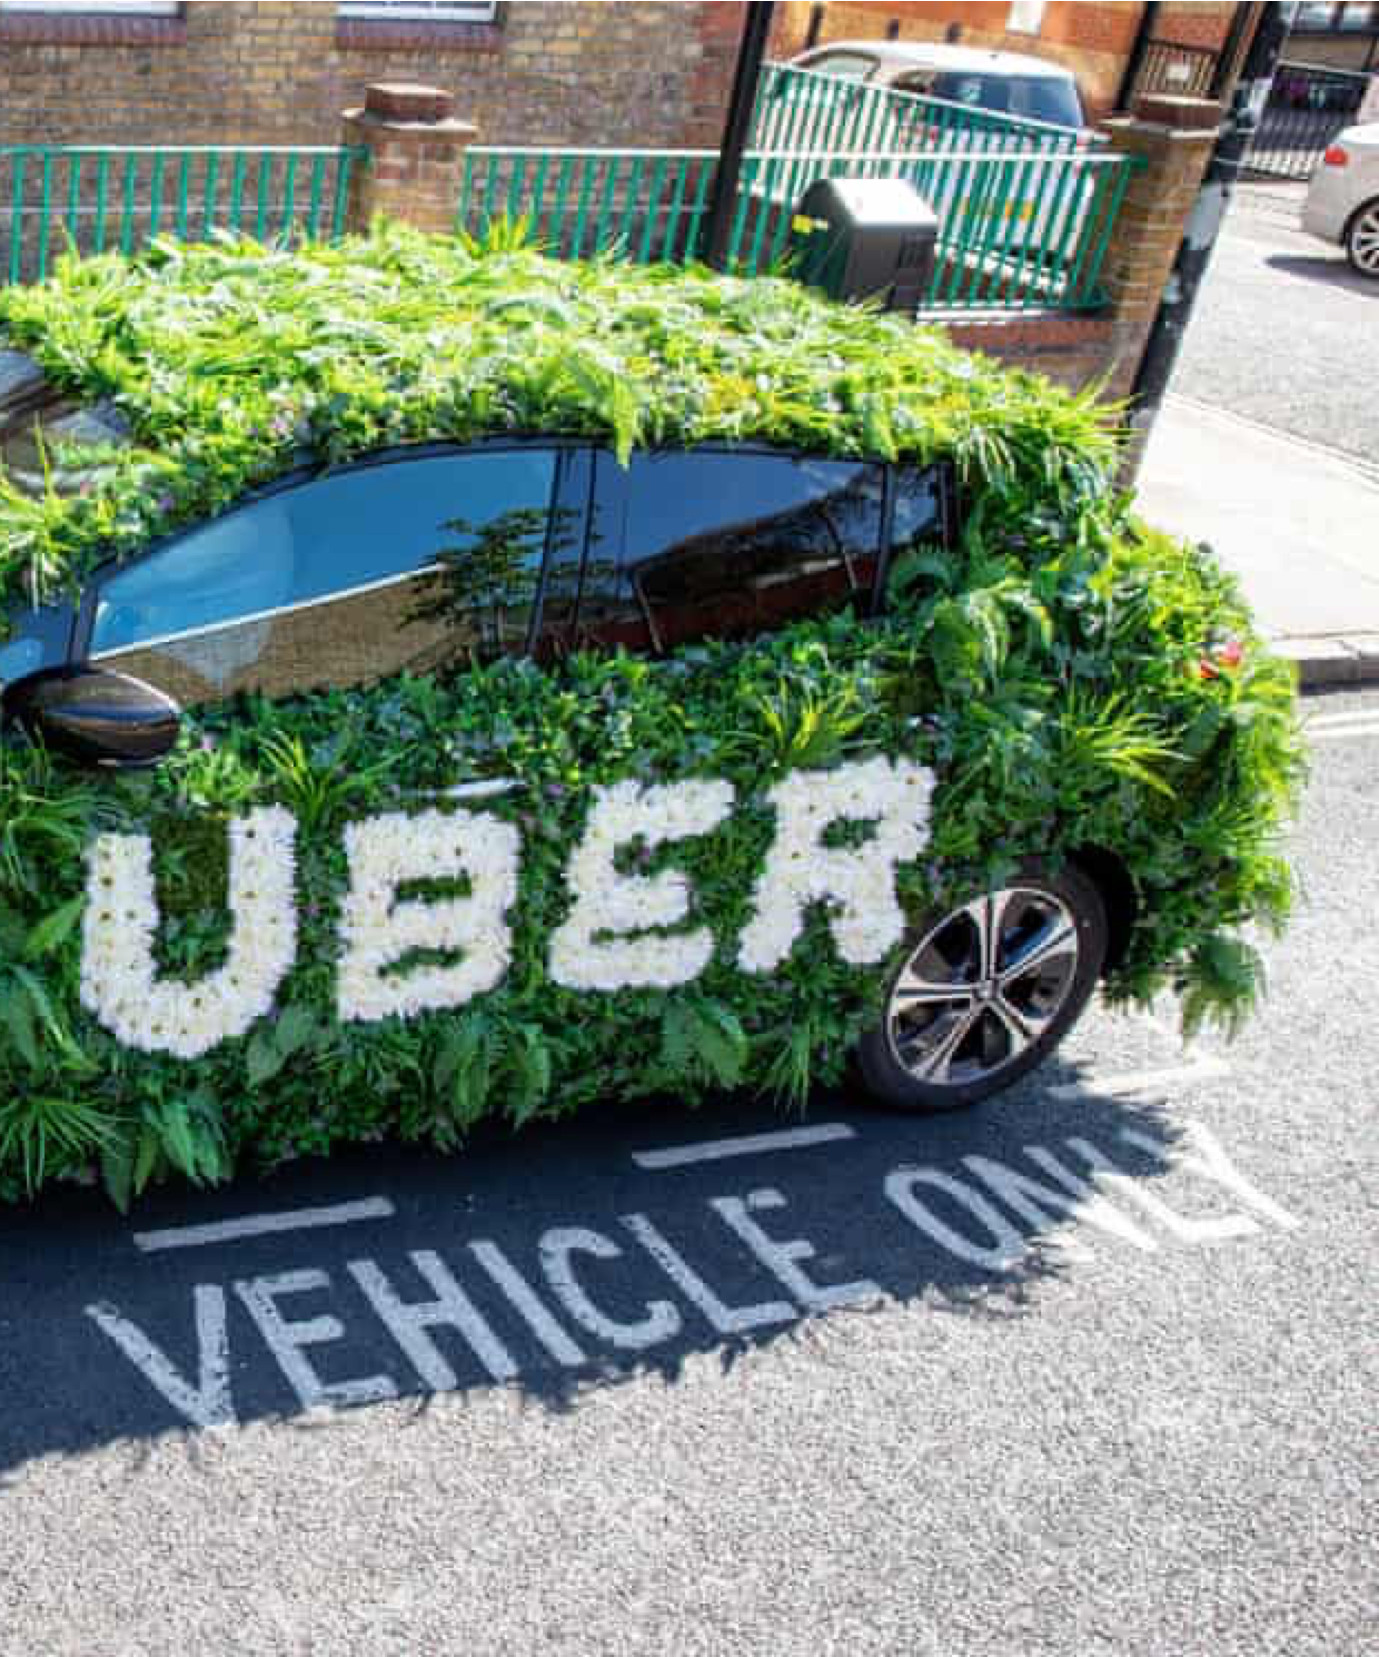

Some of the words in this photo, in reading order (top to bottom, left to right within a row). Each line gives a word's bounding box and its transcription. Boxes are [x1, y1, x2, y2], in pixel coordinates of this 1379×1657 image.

[79, 756, 937, 1060] UBER
[84, 1188, 880, 1431] VEHICLE
[884, 1118, 1302, 1272] ONLY
